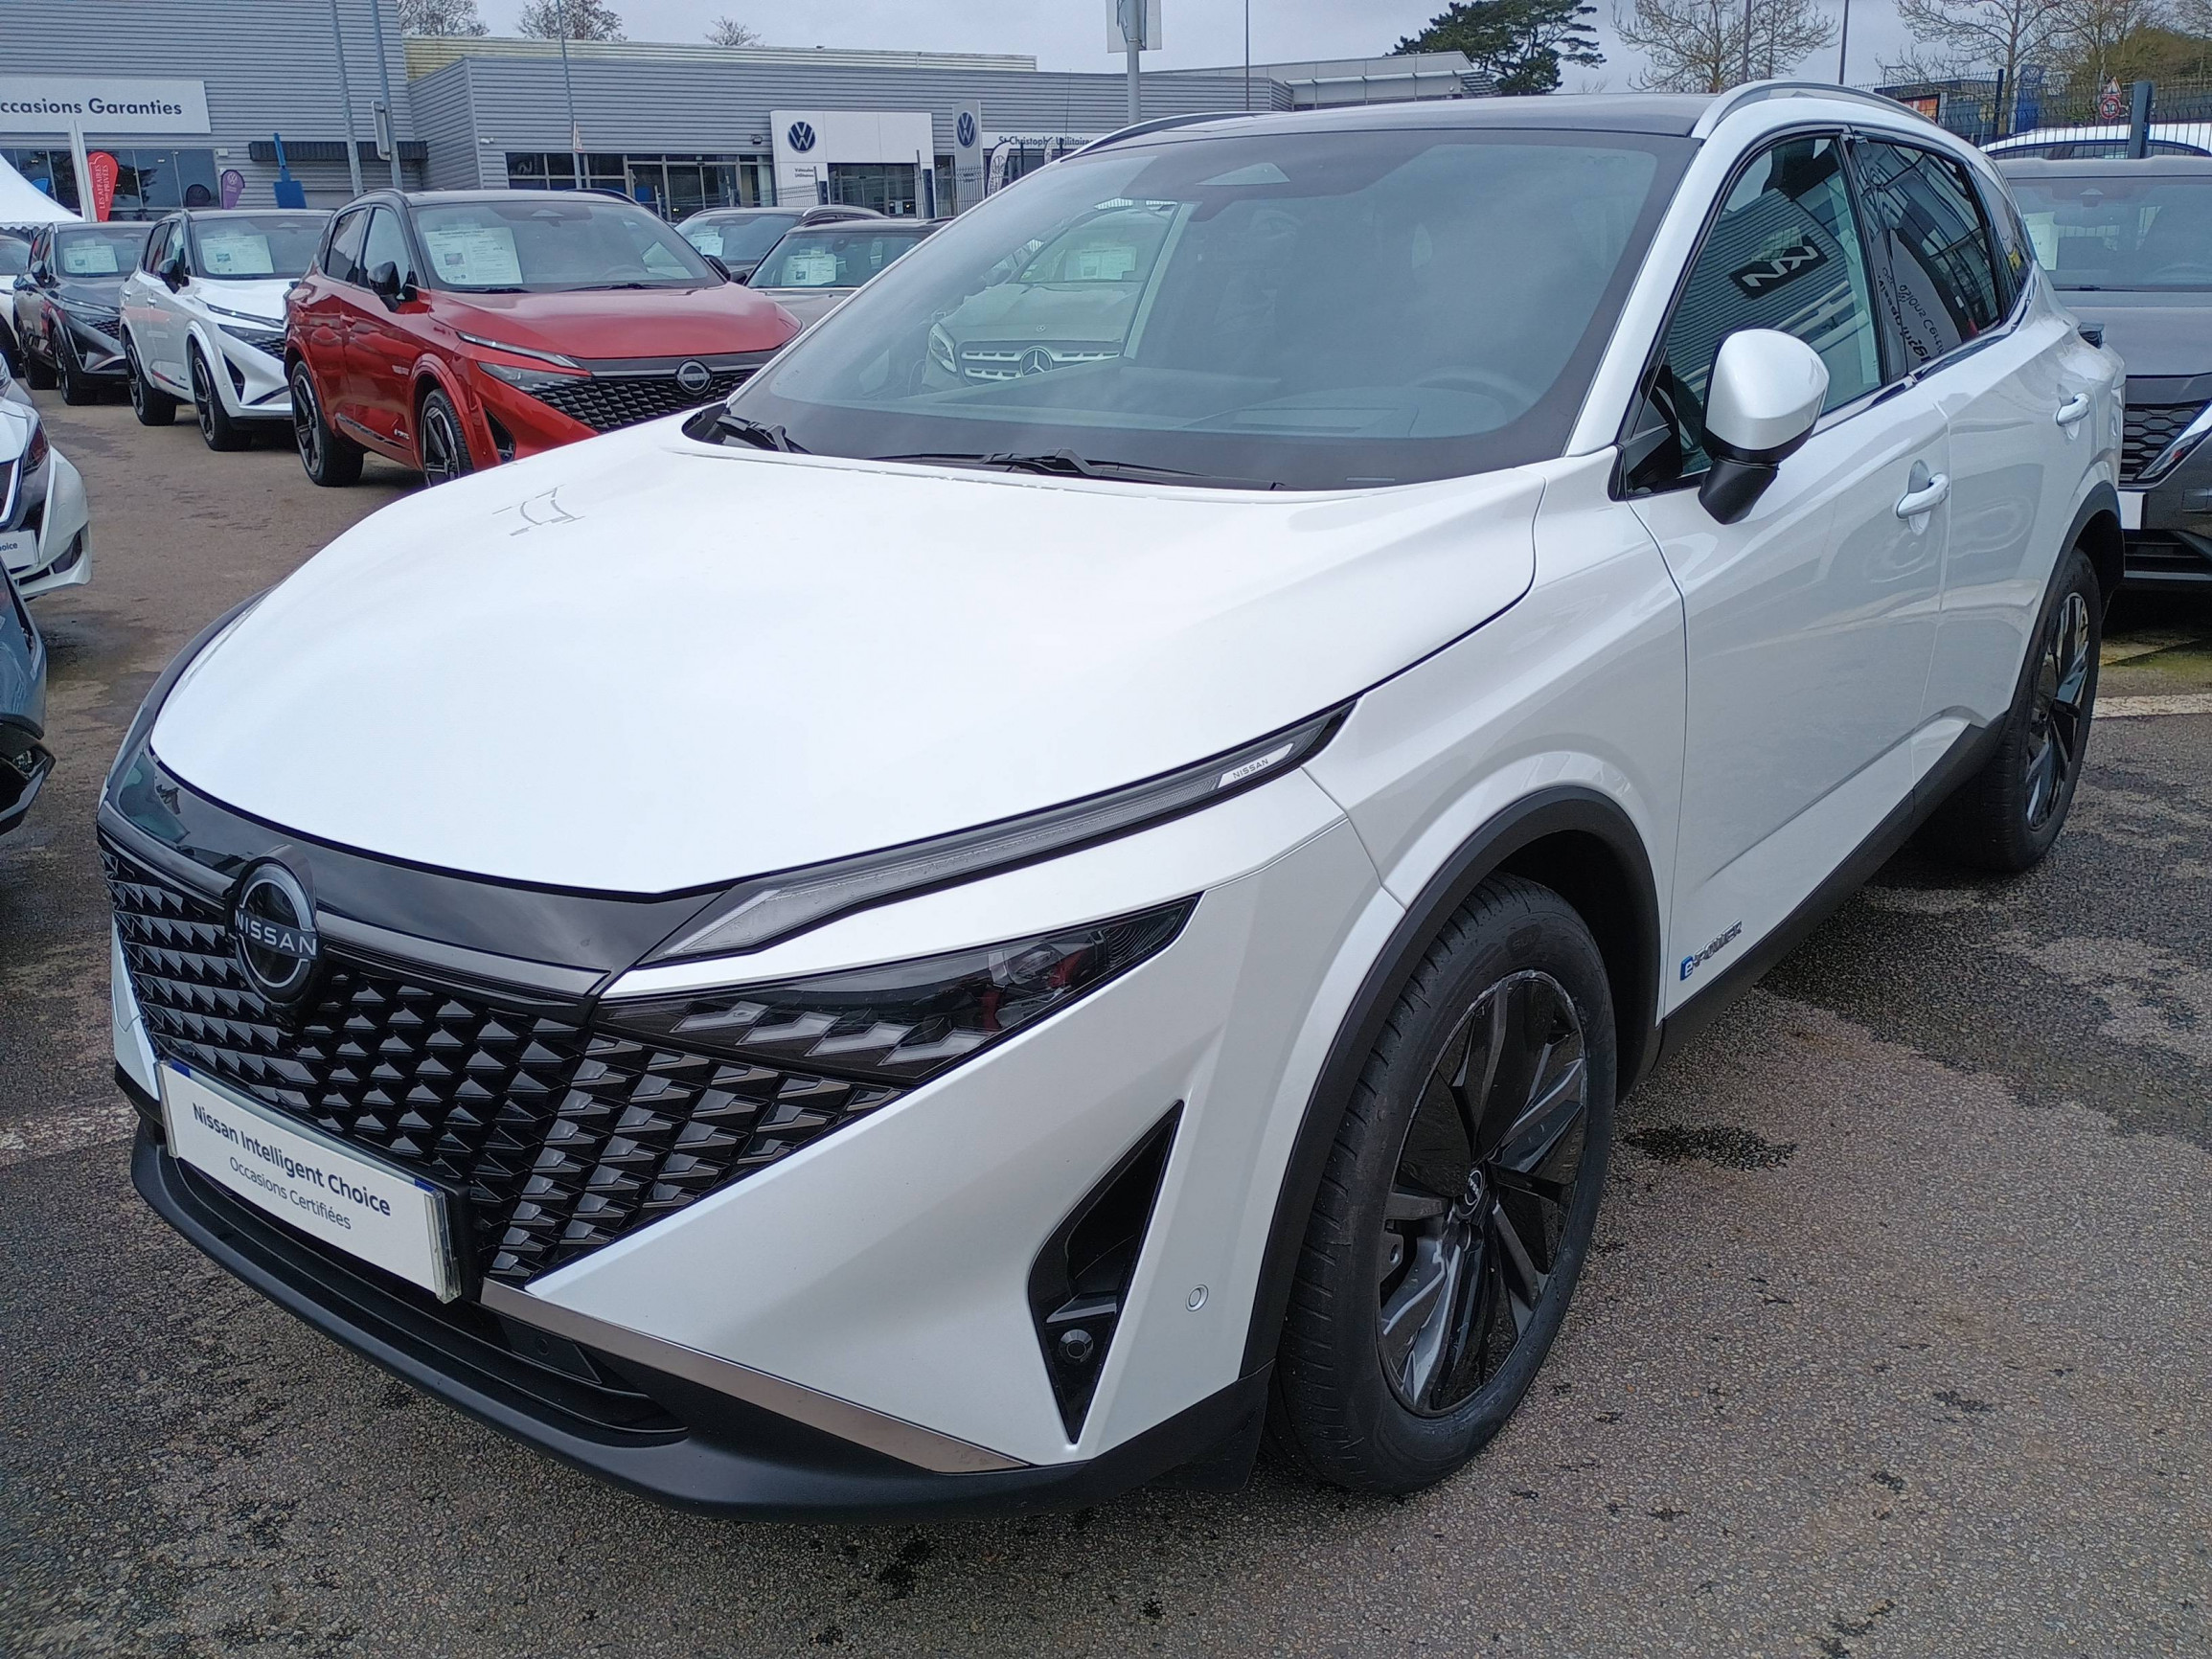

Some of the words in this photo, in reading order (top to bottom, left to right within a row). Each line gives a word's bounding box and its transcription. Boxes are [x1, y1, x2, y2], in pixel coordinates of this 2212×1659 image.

[88, 98, 182, 115] Garanties
[2105, 103, 2116, 114] 30
[1010, 136, 1052, 147] Christoph
[0, 542, 18, 552] oice
[1232, 759, 1269, 779] NISSAN
[235, 909, 317, 956] NISSAN
[192, 1102, 239, 1145] Nissan
[240, 1130, 325, 1188] Intelligent
[328, 1173, 391, 1216] Choice
[230, 1156, 287, 1198] Occasions
[289, 1190, 352, 1230] Certifiées
